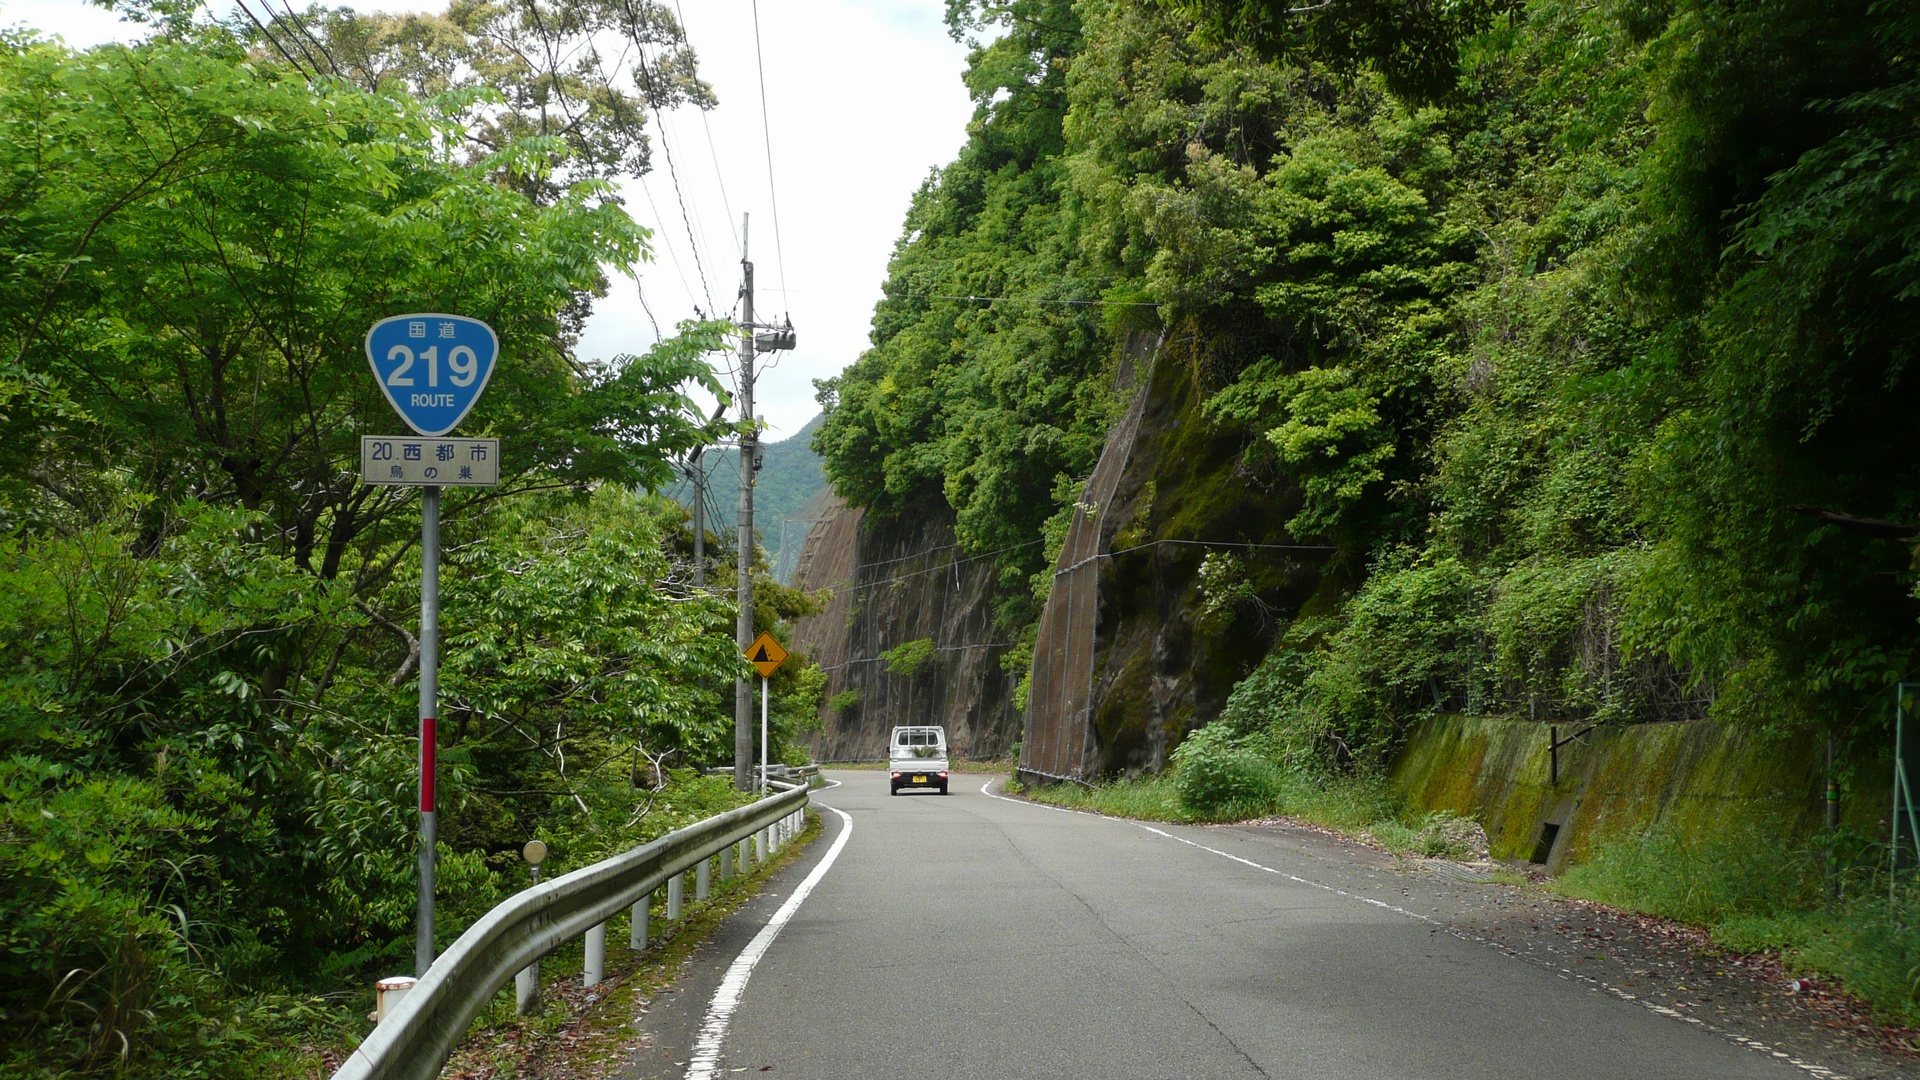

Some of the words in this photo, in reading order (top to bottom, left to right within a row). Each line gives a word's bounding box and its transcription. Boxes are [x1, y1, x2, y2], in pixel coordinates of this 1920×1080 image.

[409, 322, 456, 339] 国道
[387, 345, 478, 387] 219
[411, 394, 455, 407] ROUTE
